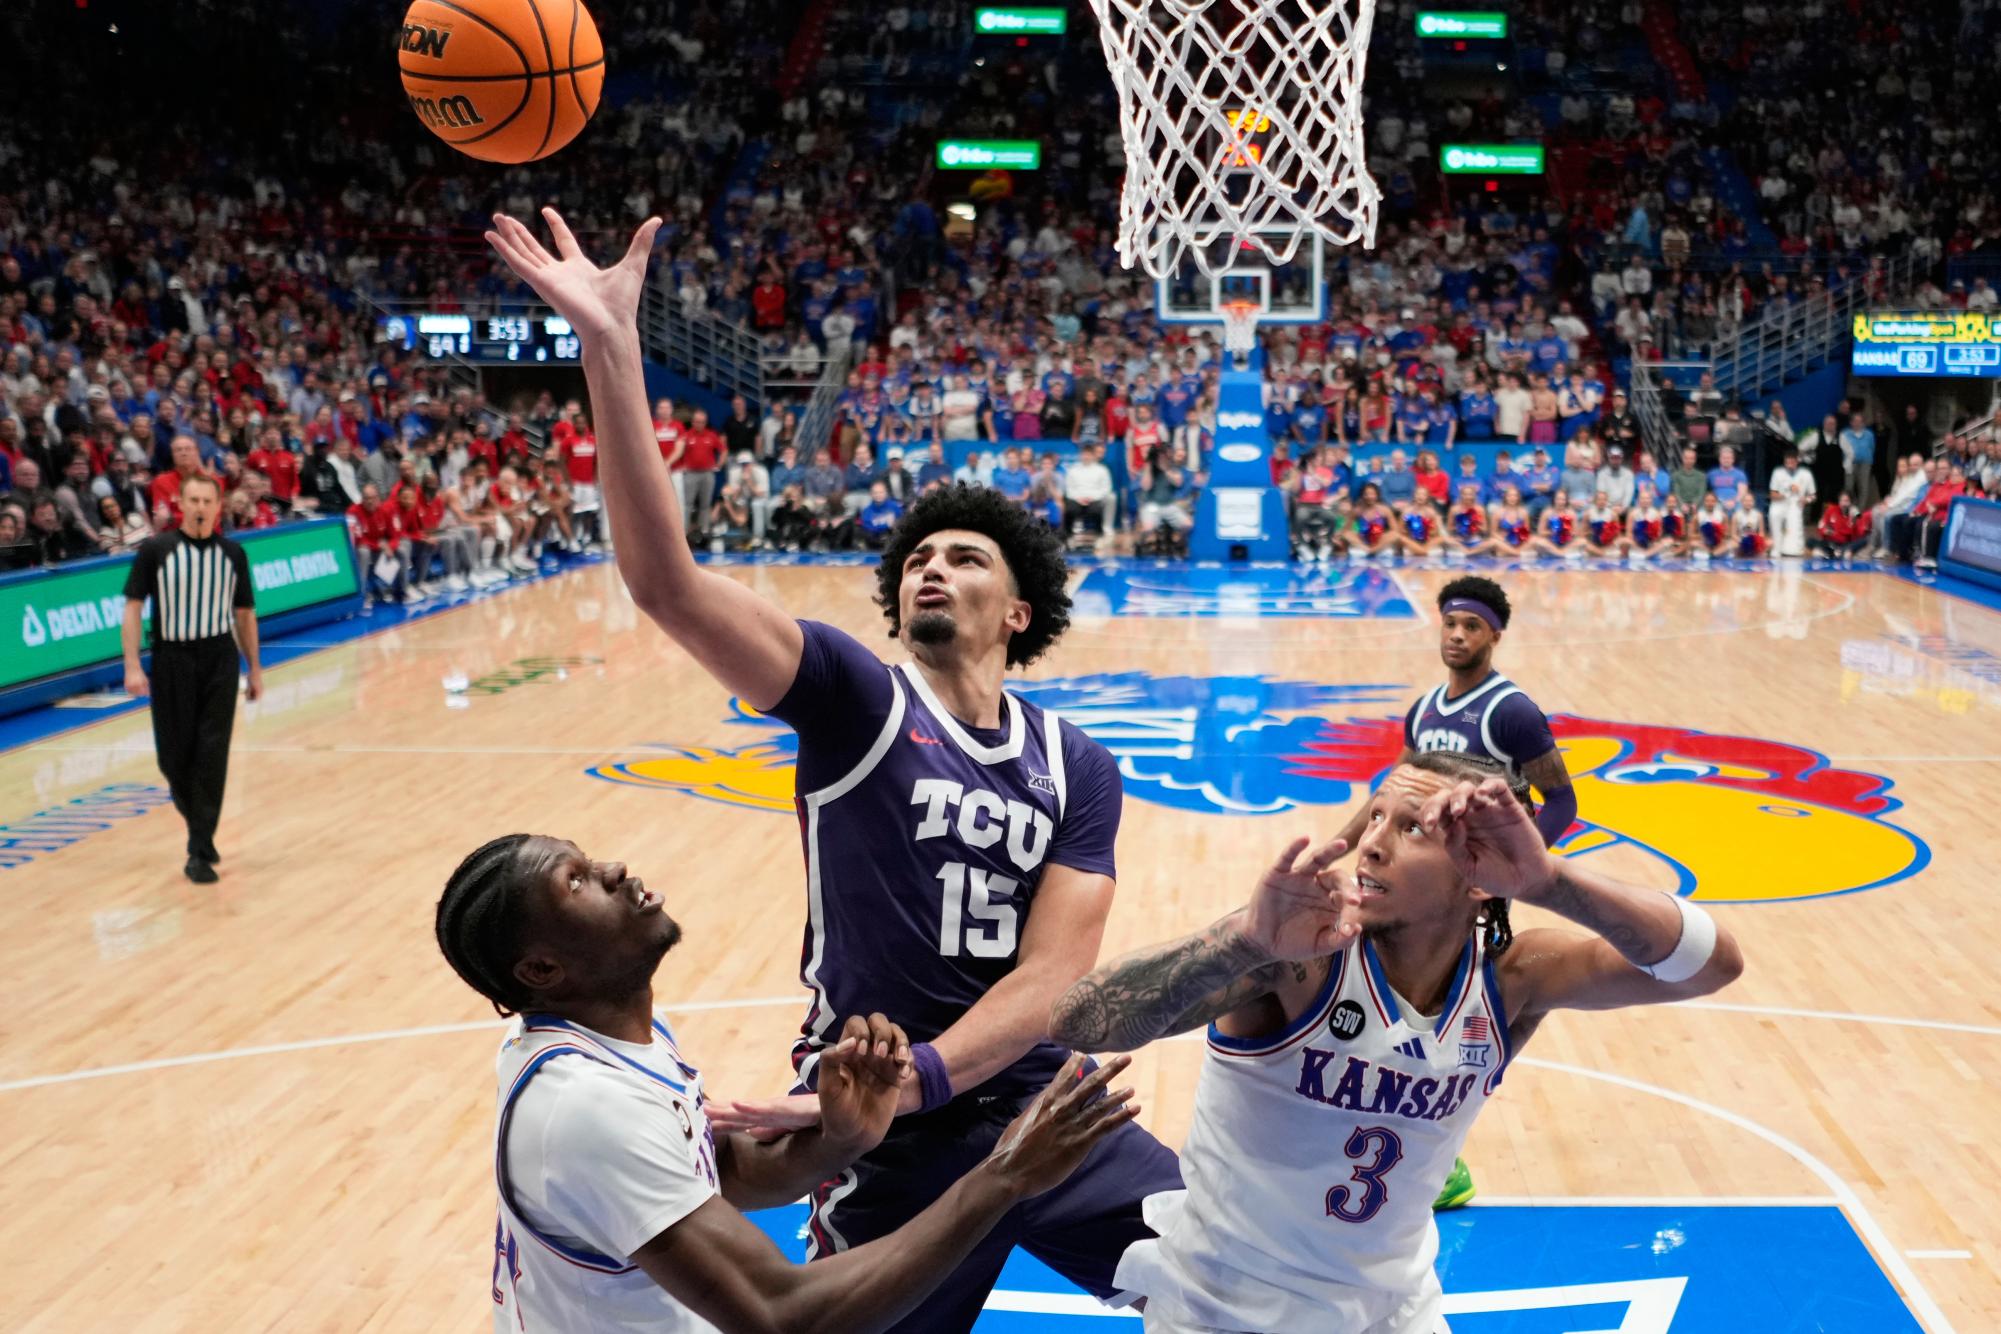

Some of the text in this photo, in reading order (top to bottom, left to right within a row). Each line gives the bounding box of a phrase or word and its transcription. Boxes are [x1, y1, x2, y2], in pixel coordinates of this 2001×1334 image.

[252, 558, 293, 592] DELTA
[46, 600, 104, 641] DELTA
[910, 778, 1054, 873] TCU
[935, 861, 1019, 958] 15
[1332, 1006, 1362, 1034] SW
[1295, 1046, 1478, 1121] KANSAS
[1325, 1126, 1404, 1223] 3
